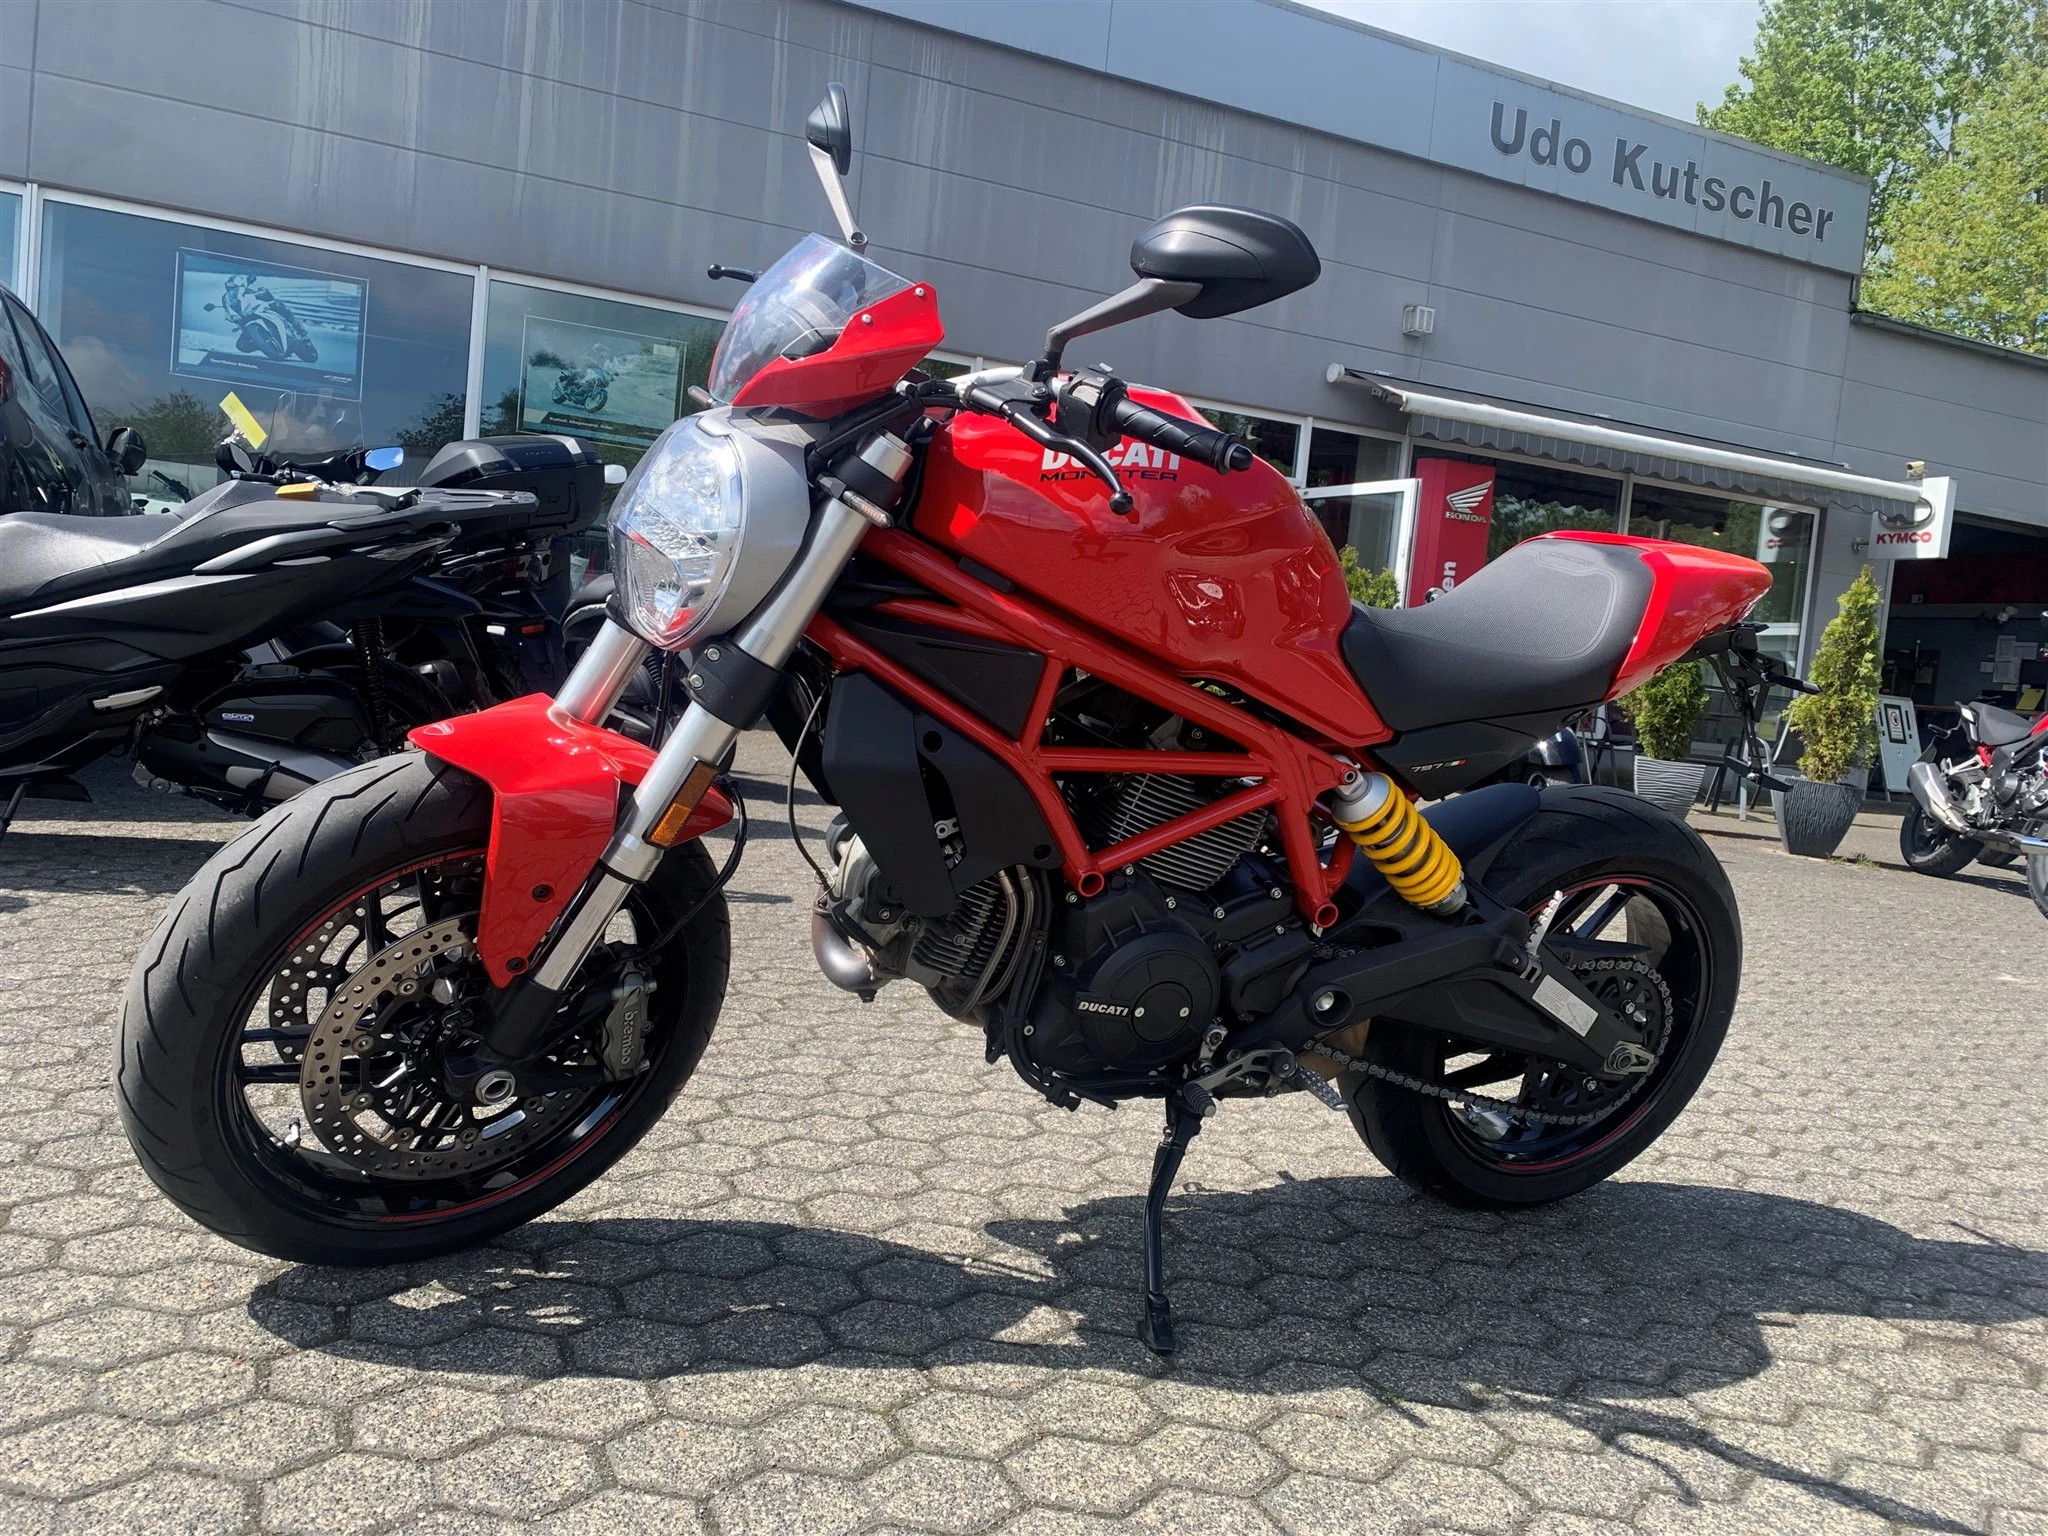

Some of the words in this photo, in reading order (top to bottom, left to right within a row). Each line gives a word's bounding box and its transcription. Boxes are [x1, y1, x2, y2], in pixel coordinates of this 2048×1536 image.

[1489, 100, 1592, 174] Udo
[1611, 137, 1834, 242] Kutscher
[1040, 468, 1179, 482] MONTER
[1445, 511, 1487, 523] HONDA
[1876, 531, 1932, 545] KYMCO
[1411, 762, 1443, 773] 797
[1078, 1001, 1129, 1017] DUCATI
[620, 1010, 639, 1066] brembo
